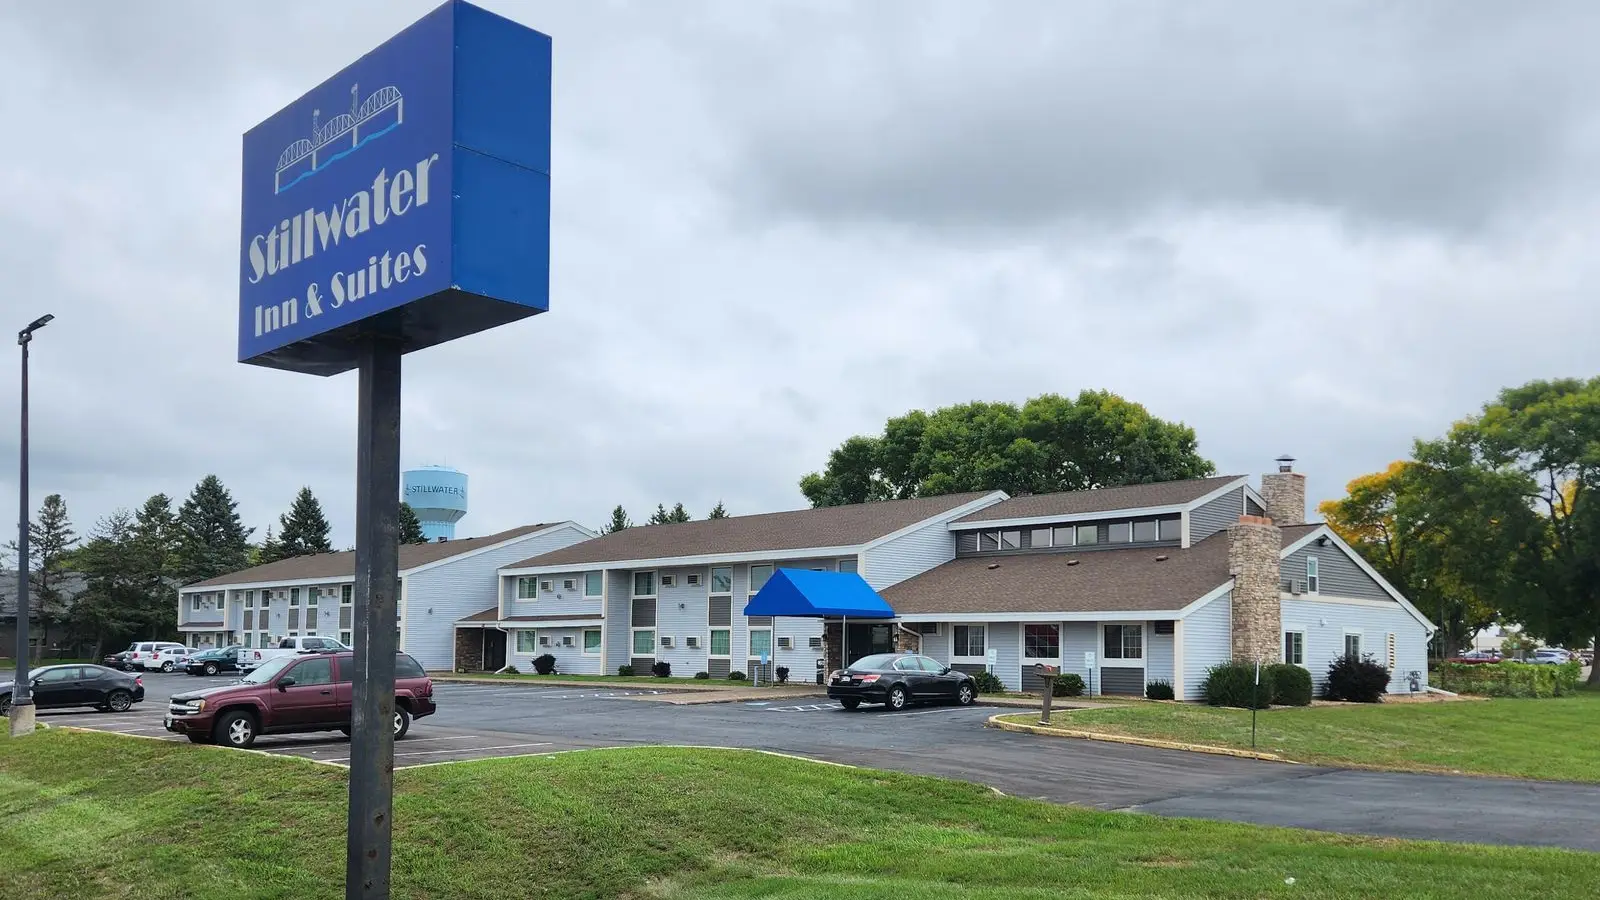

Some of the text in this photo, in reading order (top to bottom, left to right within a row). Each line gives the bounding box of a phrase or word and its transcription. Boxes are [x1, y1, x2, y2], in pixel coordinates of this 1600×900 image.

[249, 153, 439, 284] Stillwater
[255, 244, 427, 337] Inn & Suites
[411, 485, 458, 495] STILLWATER
